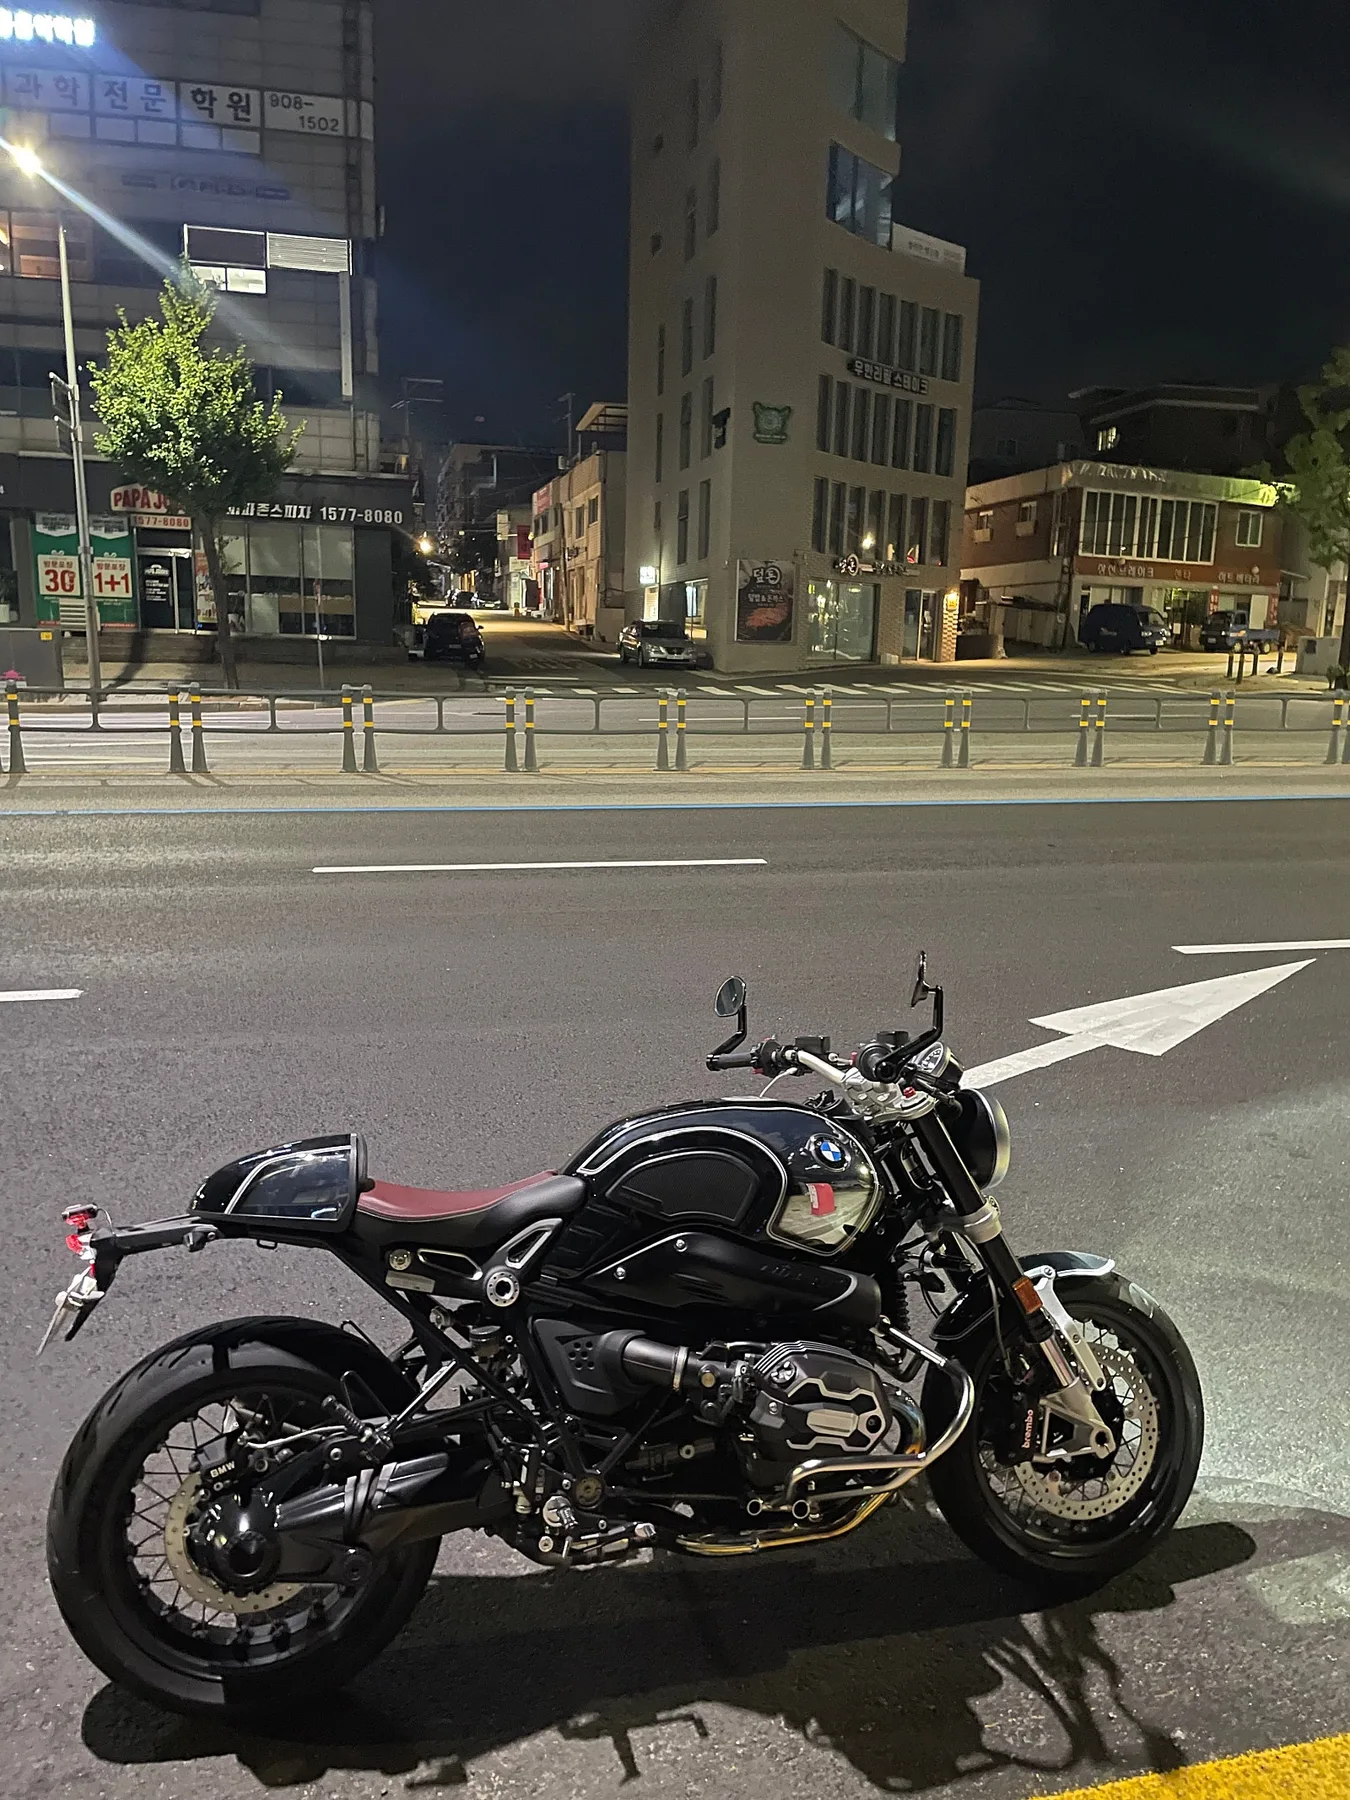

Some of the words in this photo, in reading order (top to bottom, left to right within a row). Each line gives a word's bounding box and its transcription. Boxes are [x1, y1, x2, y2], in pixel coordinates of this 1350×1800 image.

[14, 72, 81, 107] 과학
[104, 80, 167, 113] 전문
[190, 87, 251, 123] 학원
[269, 93, 314, 110] 908-
[299, 115, 339, 132] 1502
[113, 488, 151, 508] PAPA
[320, 506, 402, 524] 1577-8080
[94, 572, 130, 593] 1+1
[1021, 1408, 1034, 1448] brembo
[210, 1460, 235, 1478] BMW
